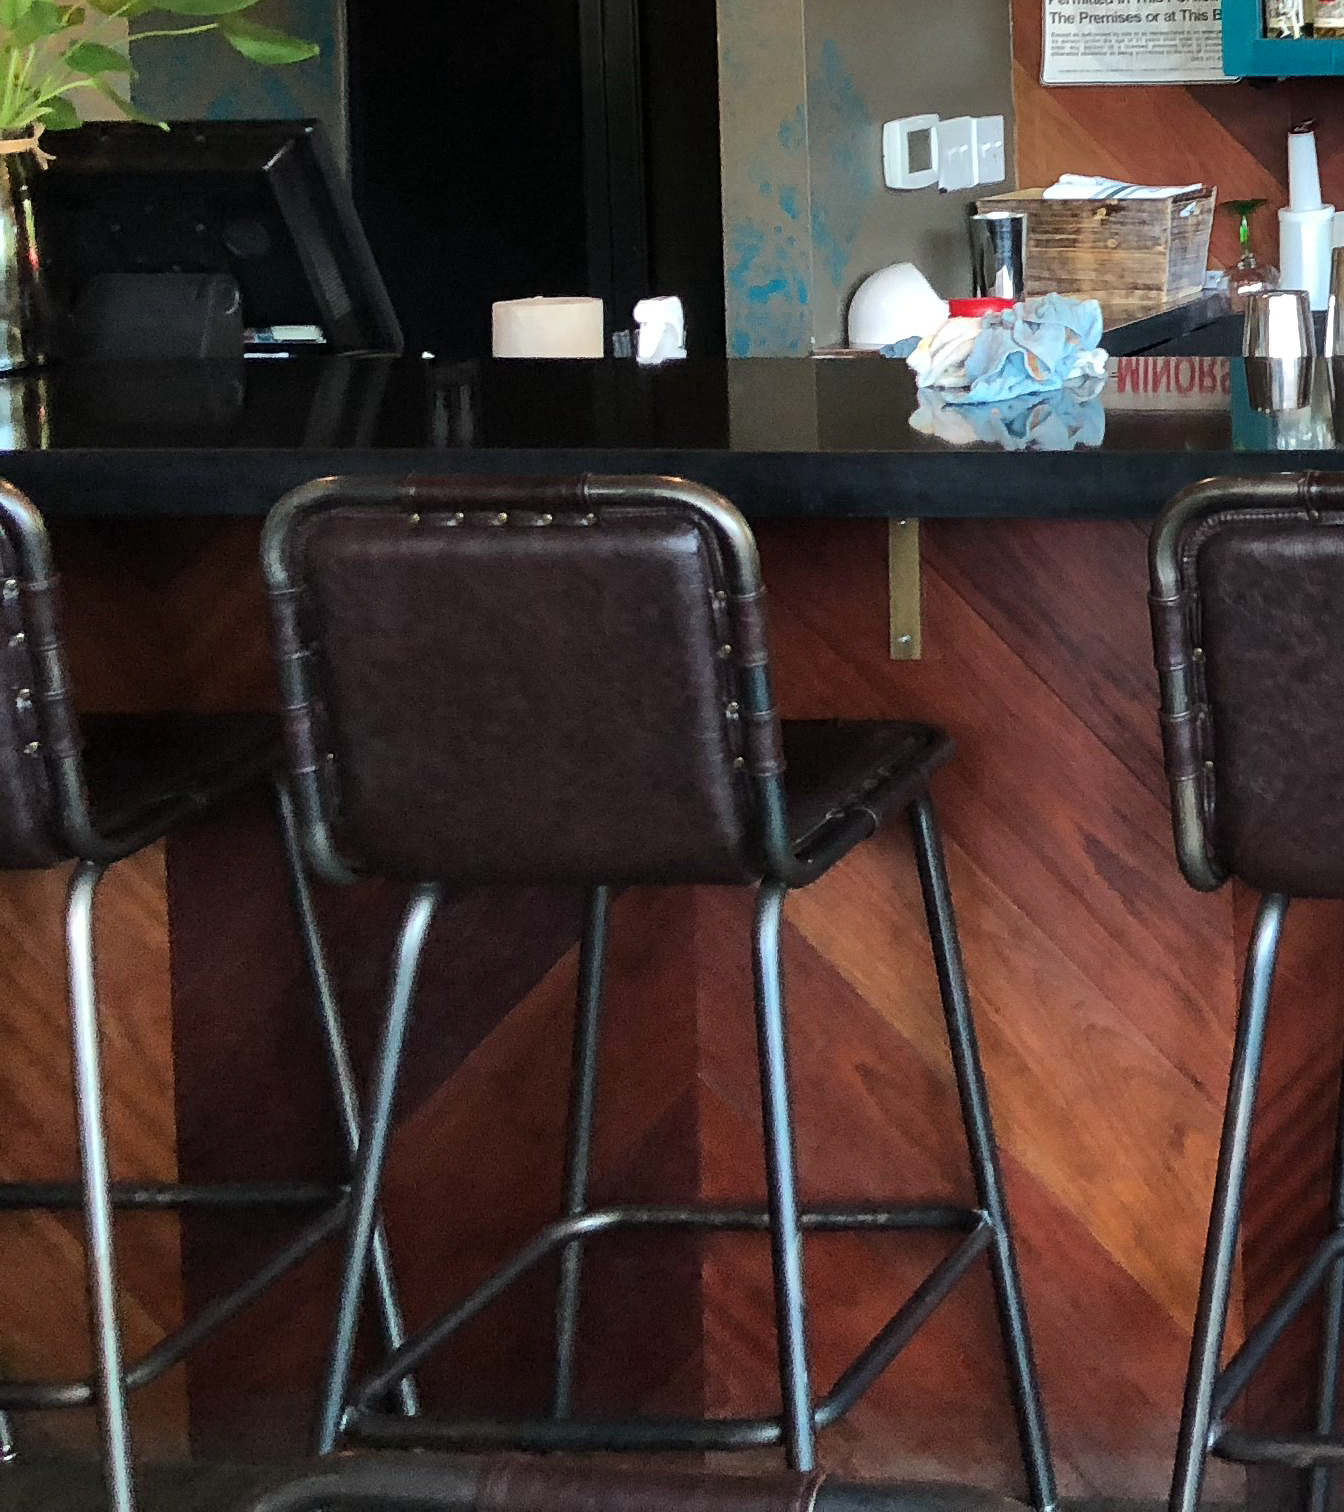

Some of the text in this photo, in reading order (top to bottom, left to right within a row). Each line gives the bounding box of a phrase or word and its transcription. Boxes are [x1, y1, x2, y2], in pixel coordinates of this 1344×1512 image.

[1049, 11, 1075, 25] The
[1078, 10, 1142, 25] Premises
[1145, 12, 1161, 24] or
[1163, 9, 1177, 23] at
[1179, 8, 1209, 22] This
